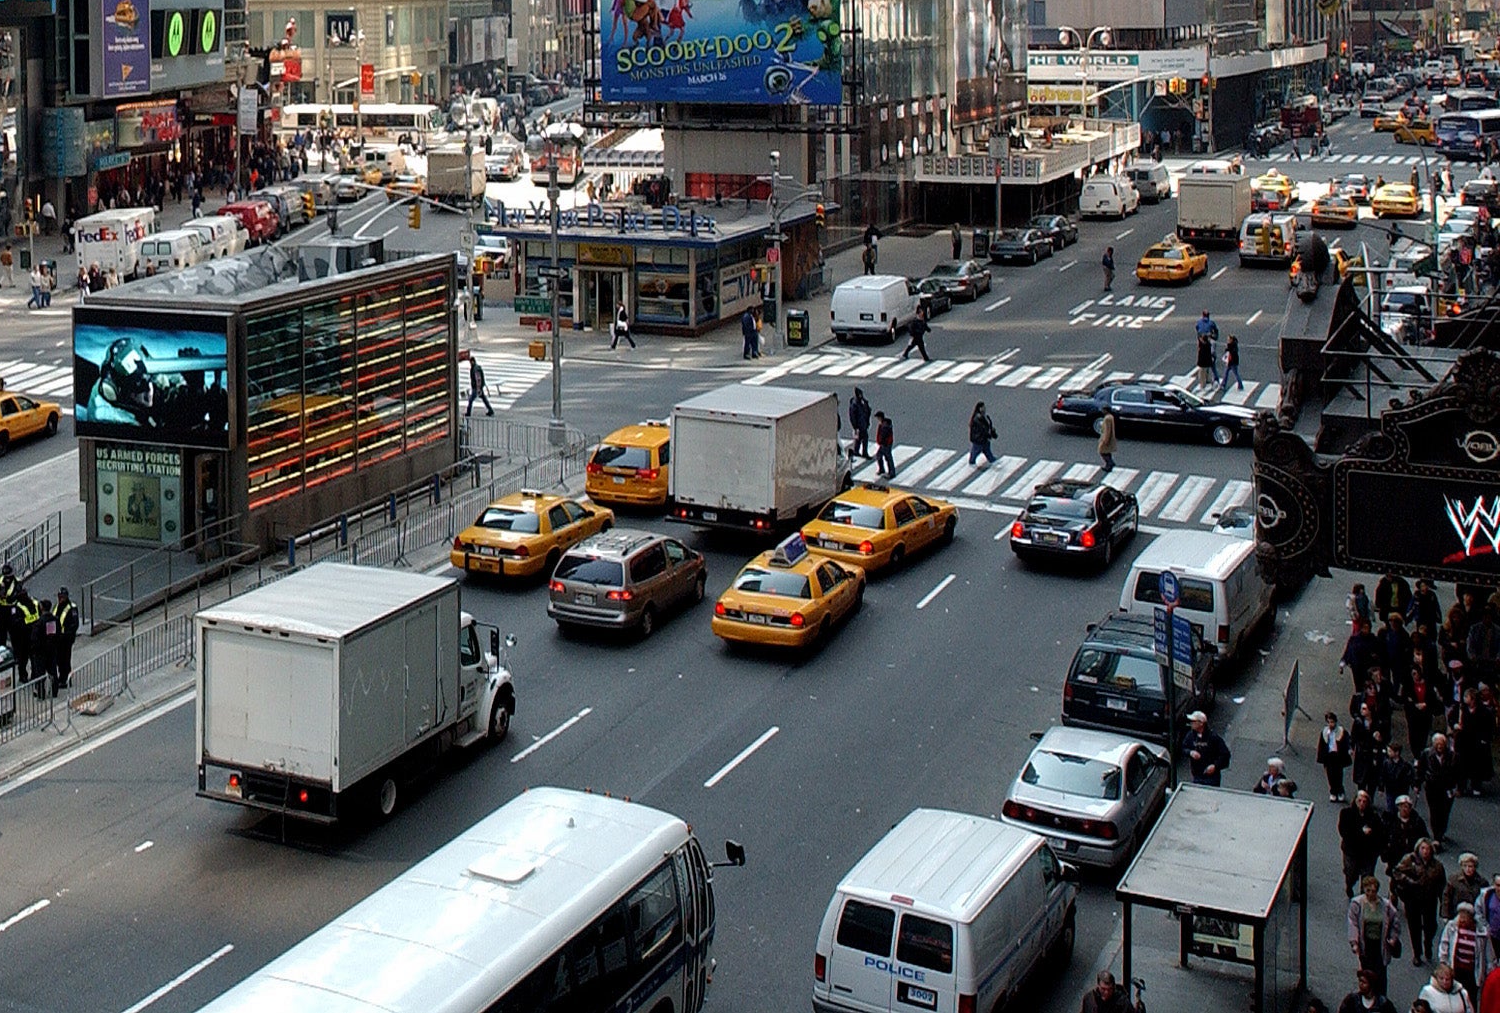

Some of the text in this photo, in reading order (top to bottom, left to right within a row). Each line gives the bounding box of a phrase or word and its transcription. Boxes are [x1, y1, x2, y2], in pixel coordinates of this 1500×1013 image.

[616, 23, 798, 74] SCOOBY-DOO 2
[629, 54, 762, 83] MONSTERS UNLEASHED
[687, 73, 719, 86] MARCH
[77, 226, 119, 244] FedEx
[1097, 293, 1176, 309] LANE
[1068, 313, 1153, 329] FIRE
[1455, 437, 1500, 453] WORL
[96, 447, 181, 465] US ARMED FORCES
[96, 459, 181, 476] RECRUITING STATION
[864, 955, 927, 983] POLICE
